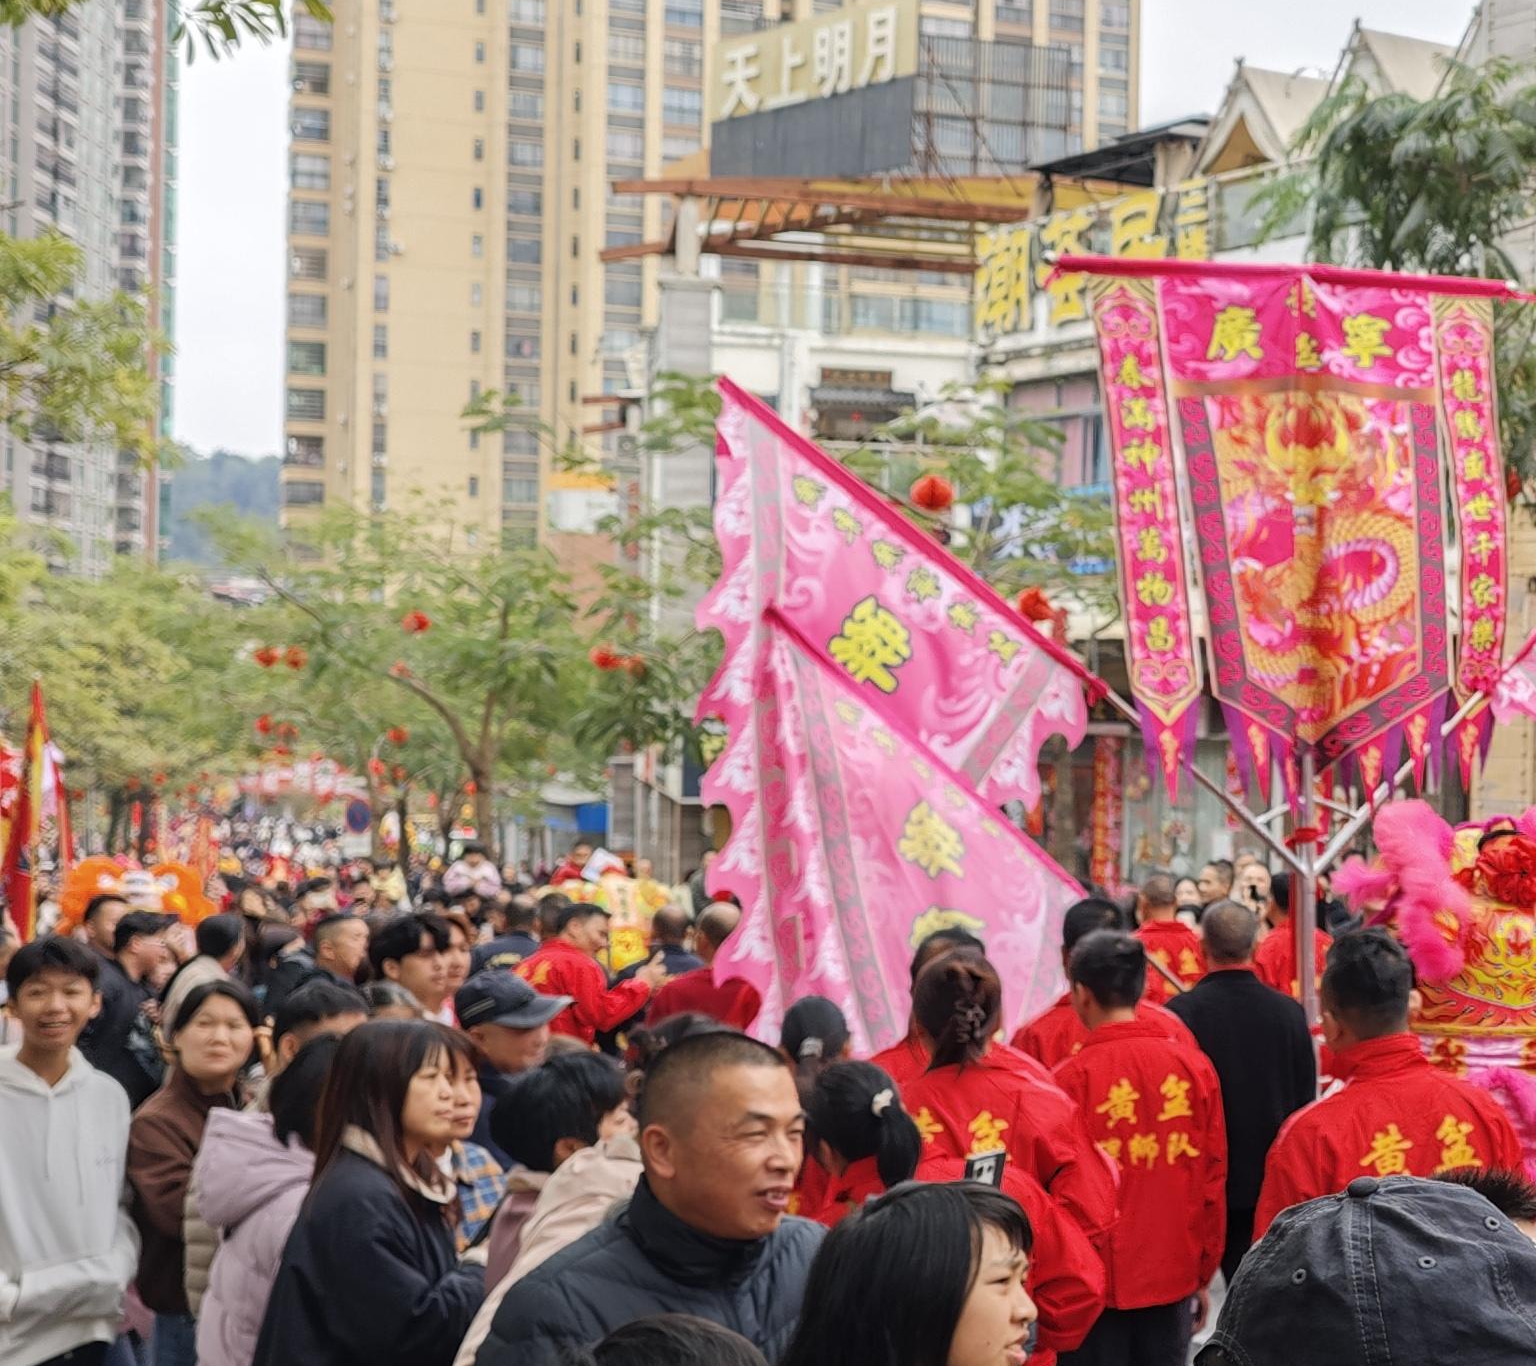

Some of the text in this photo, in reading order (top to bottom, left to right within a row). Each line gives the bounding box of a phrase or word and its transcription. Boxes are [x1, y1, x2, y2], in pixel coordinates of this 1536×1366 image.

[720, 7, 897, 121] 天上明月
[1096, 1073, 1193, 1128] 黄盆
[1358, 1113, 1483, 1178] 黄盆
